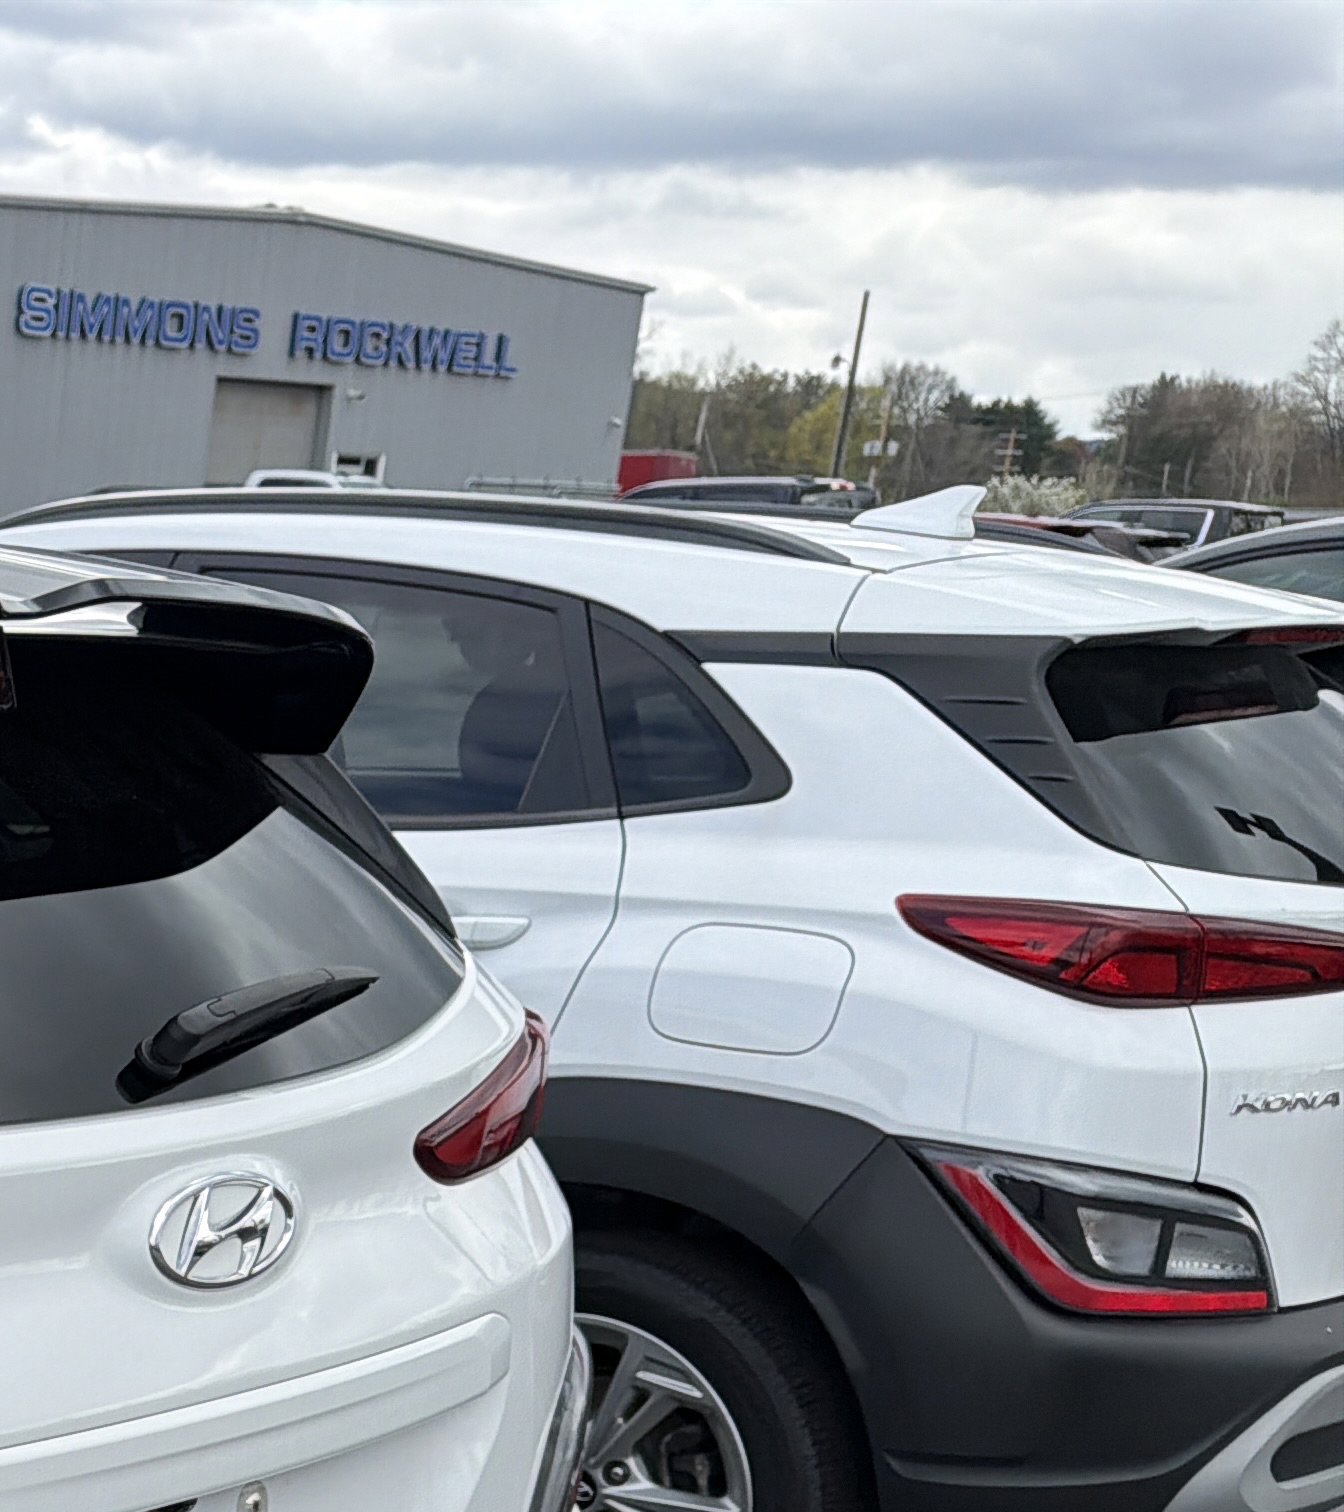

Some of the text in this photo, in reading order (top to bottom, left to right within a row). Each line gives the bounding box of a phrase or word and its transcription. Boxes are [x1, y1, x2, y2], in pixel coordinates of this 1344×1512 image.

[16, 281, 519, 378] SIMMONS ROCKWELL
[1229, 1088, 1340, 1117] KONA
